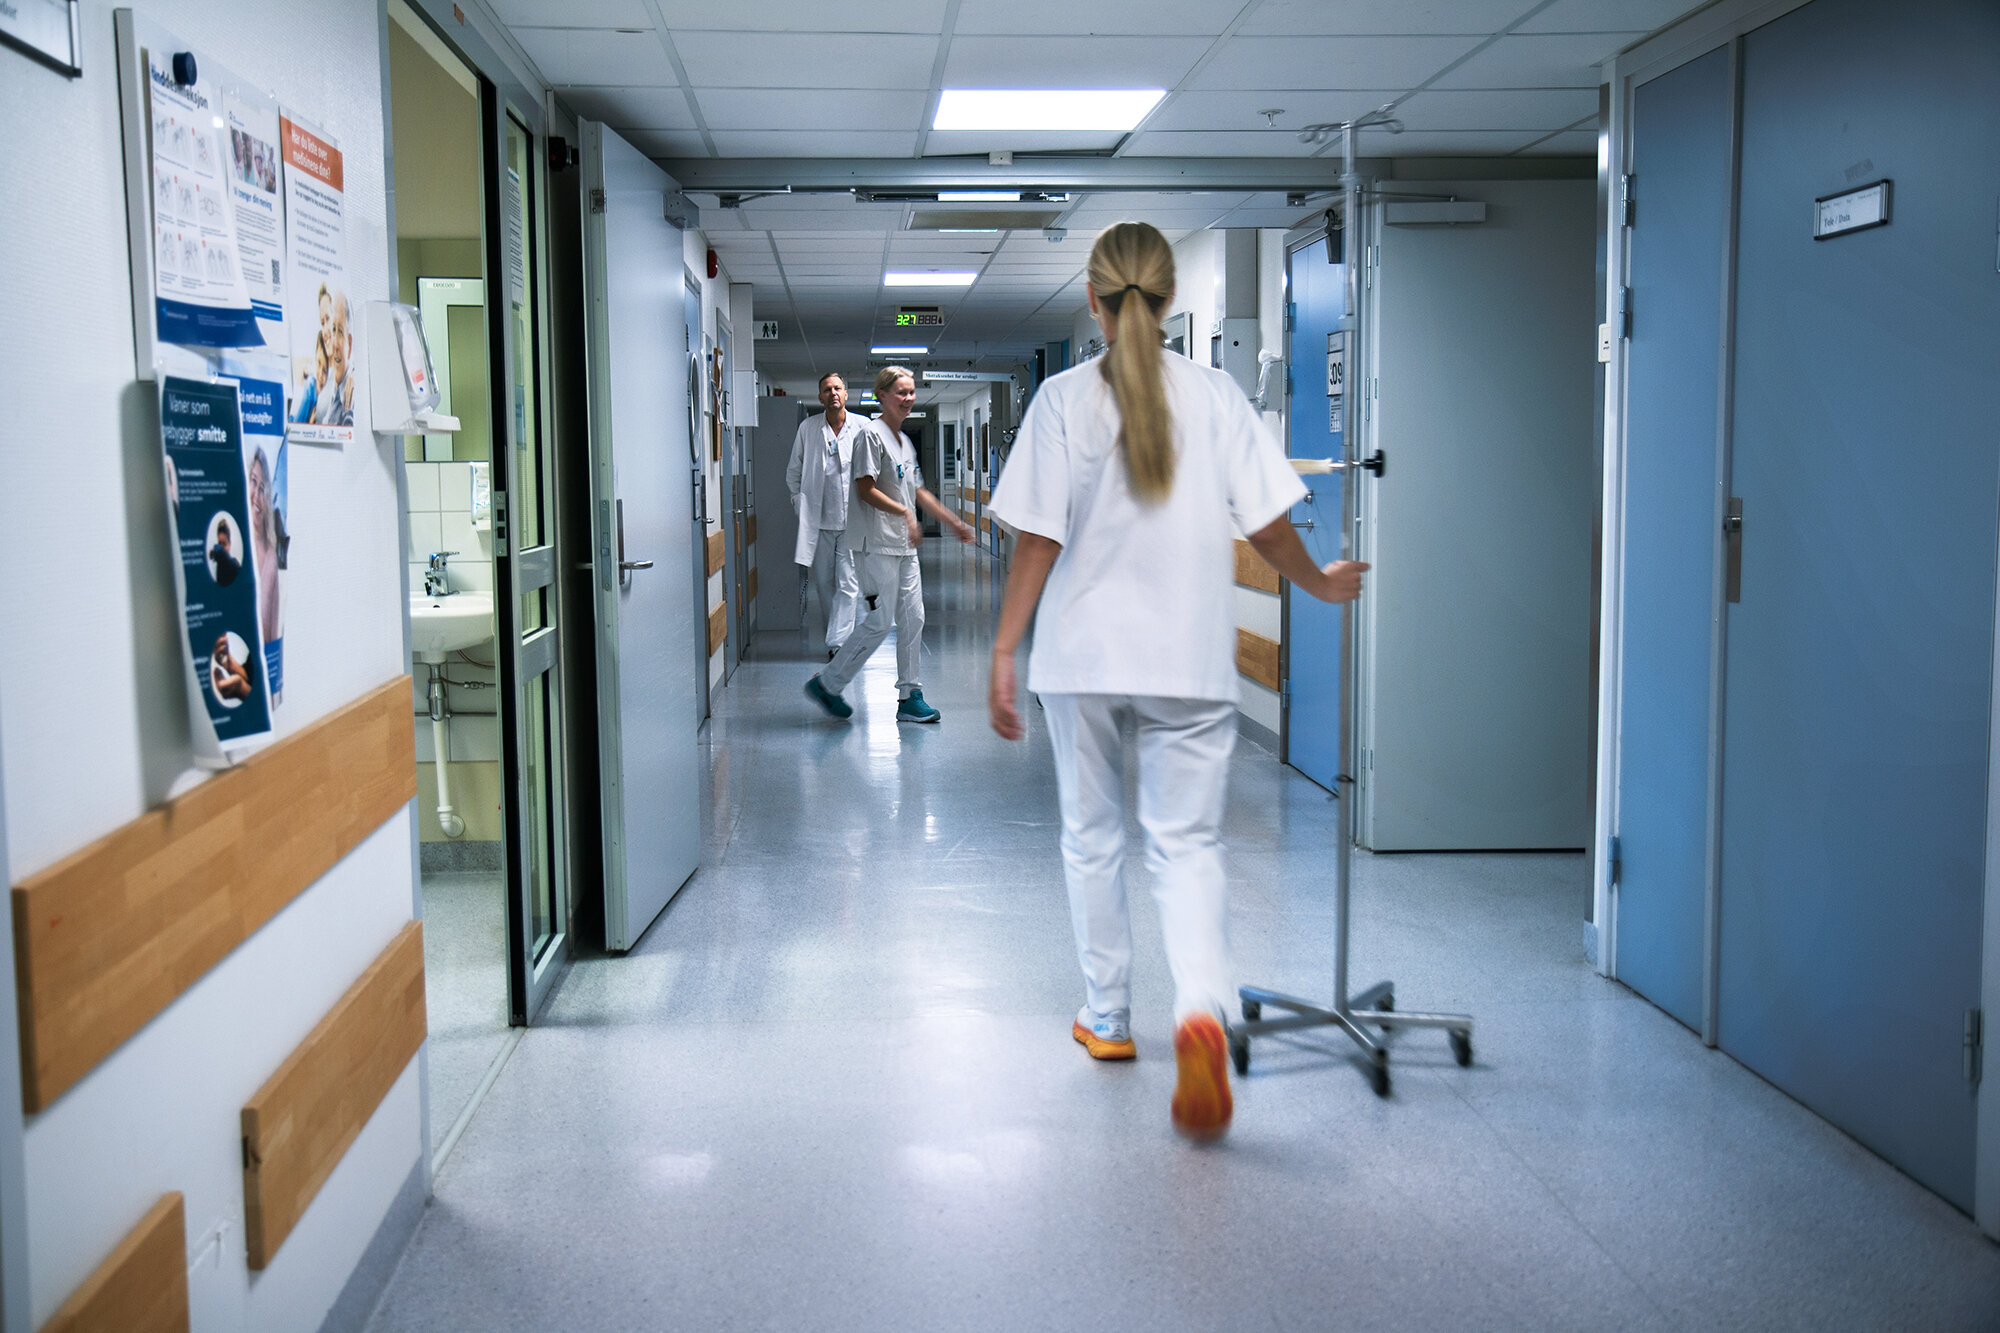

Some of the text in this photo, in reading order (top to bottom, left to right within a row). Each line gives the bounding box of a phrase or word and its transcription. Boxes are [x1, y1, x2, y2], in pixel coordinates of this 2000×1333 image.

[291, 128, 328, 161] Har du liste over
[293, 150, 331, 180] medisinene dine?
[259, 198, 272, 212] mening
[1824, 217, 1835, 228] Tele
[1838, 214, 1851, 224] Data
[896, 314, 917, 326] 327
[168, 393, 211, 416] Vaner som
[255, 395, 262, 404] om
[197, 424, 227, 443] smitte
